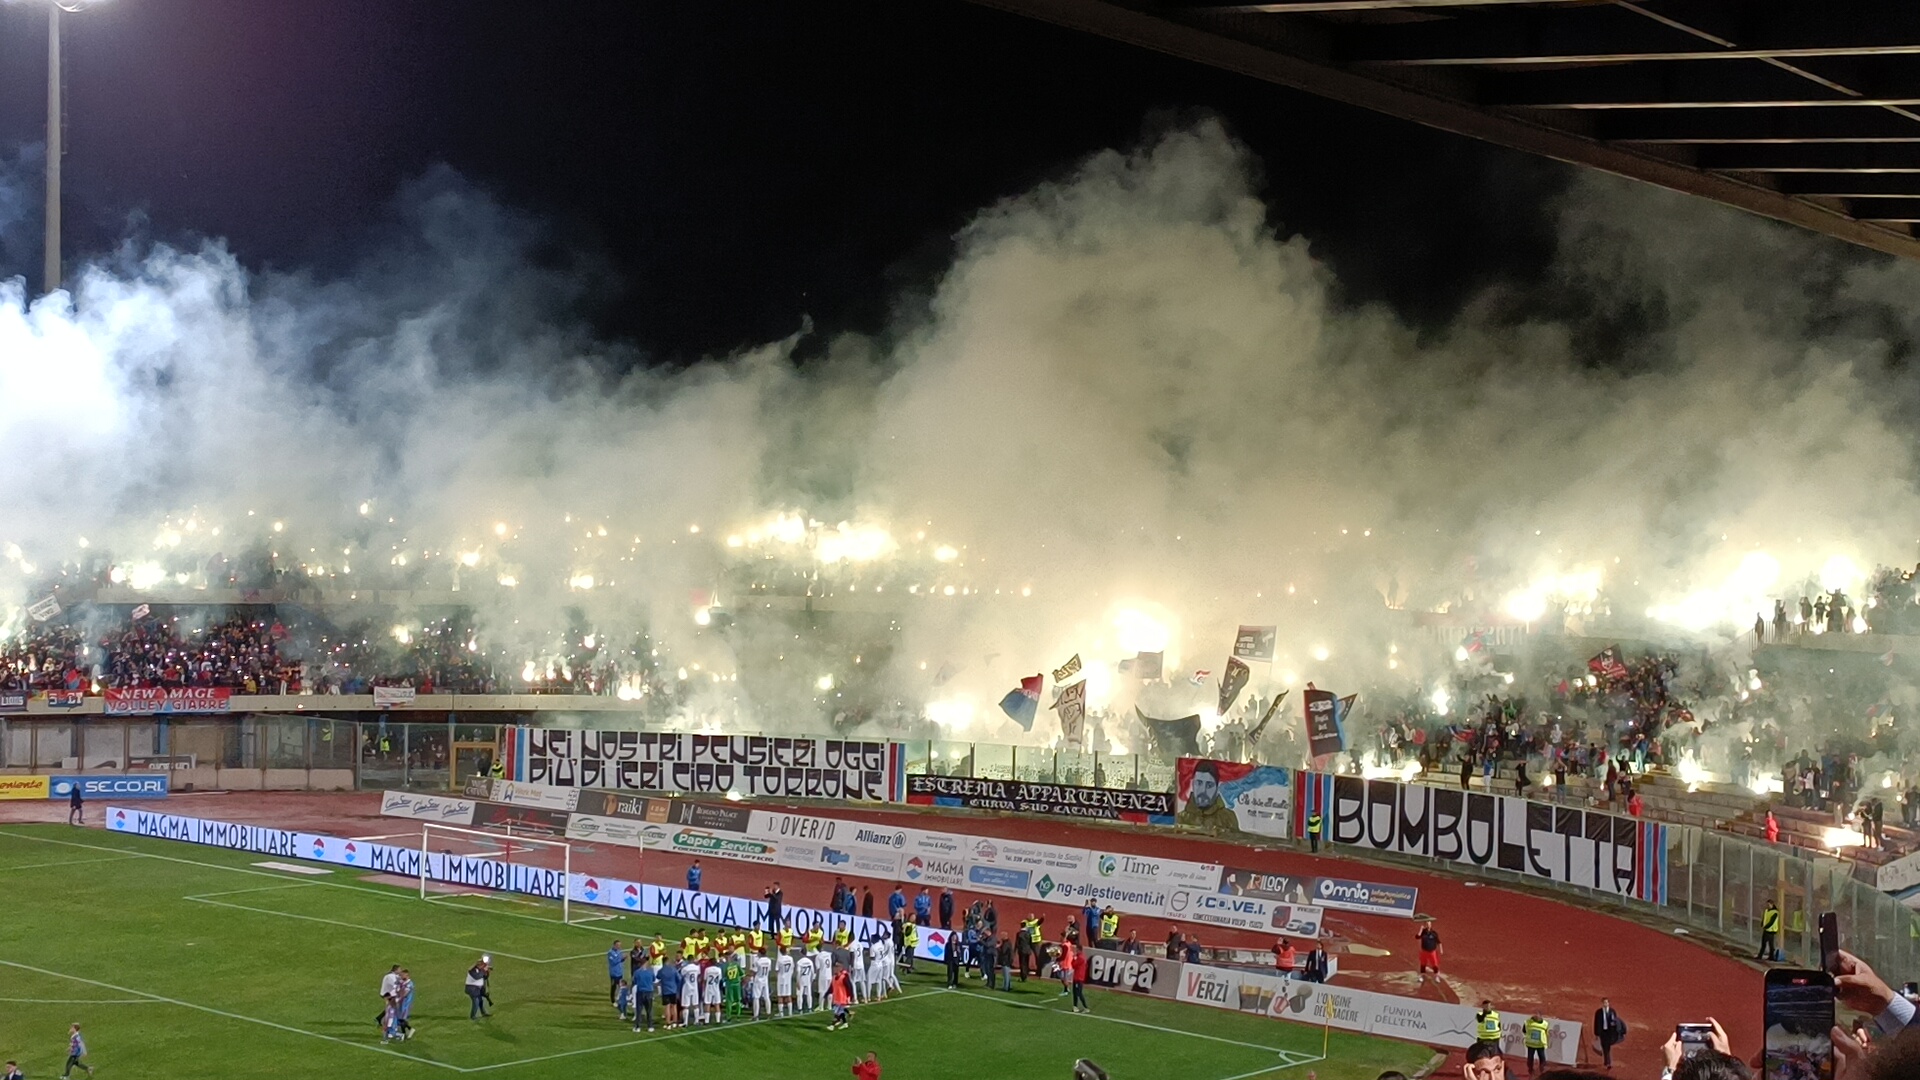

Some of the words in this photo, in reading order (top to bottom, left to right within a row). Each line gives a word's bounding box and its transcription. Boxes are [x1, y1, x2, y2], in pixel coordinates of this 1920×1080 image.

[119, 688, 156, 699] NEW
[108, 699, 167, 711] VOLLEY
[172, 699, 227, 711] GIARRE
[529, 729, 571, 758] NEI
[581, 730, 682, 761] NOSTRI
[692, 733, 816, 767] PENSIERI
[825, 740, 884, 771] OGGI
[581, 759, 606, 788] DI
[616, 760, 663, 790] IERI
[673, 761, 734, 793] CIAO
[743, 765, 882, 800] TORRONE
[911, 777, 1007, 799] ESTREMA
[1016, 783, 1169, 813] APPARTENENZA
[617, 798, 643, 816] raiki
[969, 798, 1016, 811] CURVA
[1019, 802, 1049, 813] SUD
[1053, 804, 1112, 818] CATANIA
[138, 812, 190, 841] MAGMA
[197, 819, 297, 857] IMMOBILIARE
[780, 815, 836, 841] OVER/D
[1333, 775, 1637, 897] BOMBOLETTA
[678, 833, 716, 848] Paper
[720, 840, 763, 853] Service
[855, 829, 892, 845] Allianz
[672, 846, 720, 856] FORNITURE
[741, 853, 775, 862] UFFICIO
[371, 844, 433, 879] MAGMA
[442, 854, 566, 898] IMMOBILIARE
[926, 860, 964, 877] MAGMA
[1122, 856, 1160, 876] Time
[924, 874, 964, 886] IMMOBILIARE
[1248, 873, 1289, 892] TRILOGY
[1320, 879, 1369, 898] Omnia
[1056, 881, 1165, 907] ng-allestieventi.it
[657, 887, 738, 926] MAGMA
[1231, 917, 1247, 927] VOLVO
[760, 966, 769, 976] 11
[783, 962, 792, 973] 17
[801, 965, 812, 976] 27
[824, 958, 831, 969] 9
[708, 974, 719, 985] 24
[726, 967, 738, 979] 97
[1330, 1007, 1360, 1023] IACERE
[1382, 1004, 1423, 1019] FUNIVIA
[1374, 1014, 1428, 1031] DELL'ETNA
